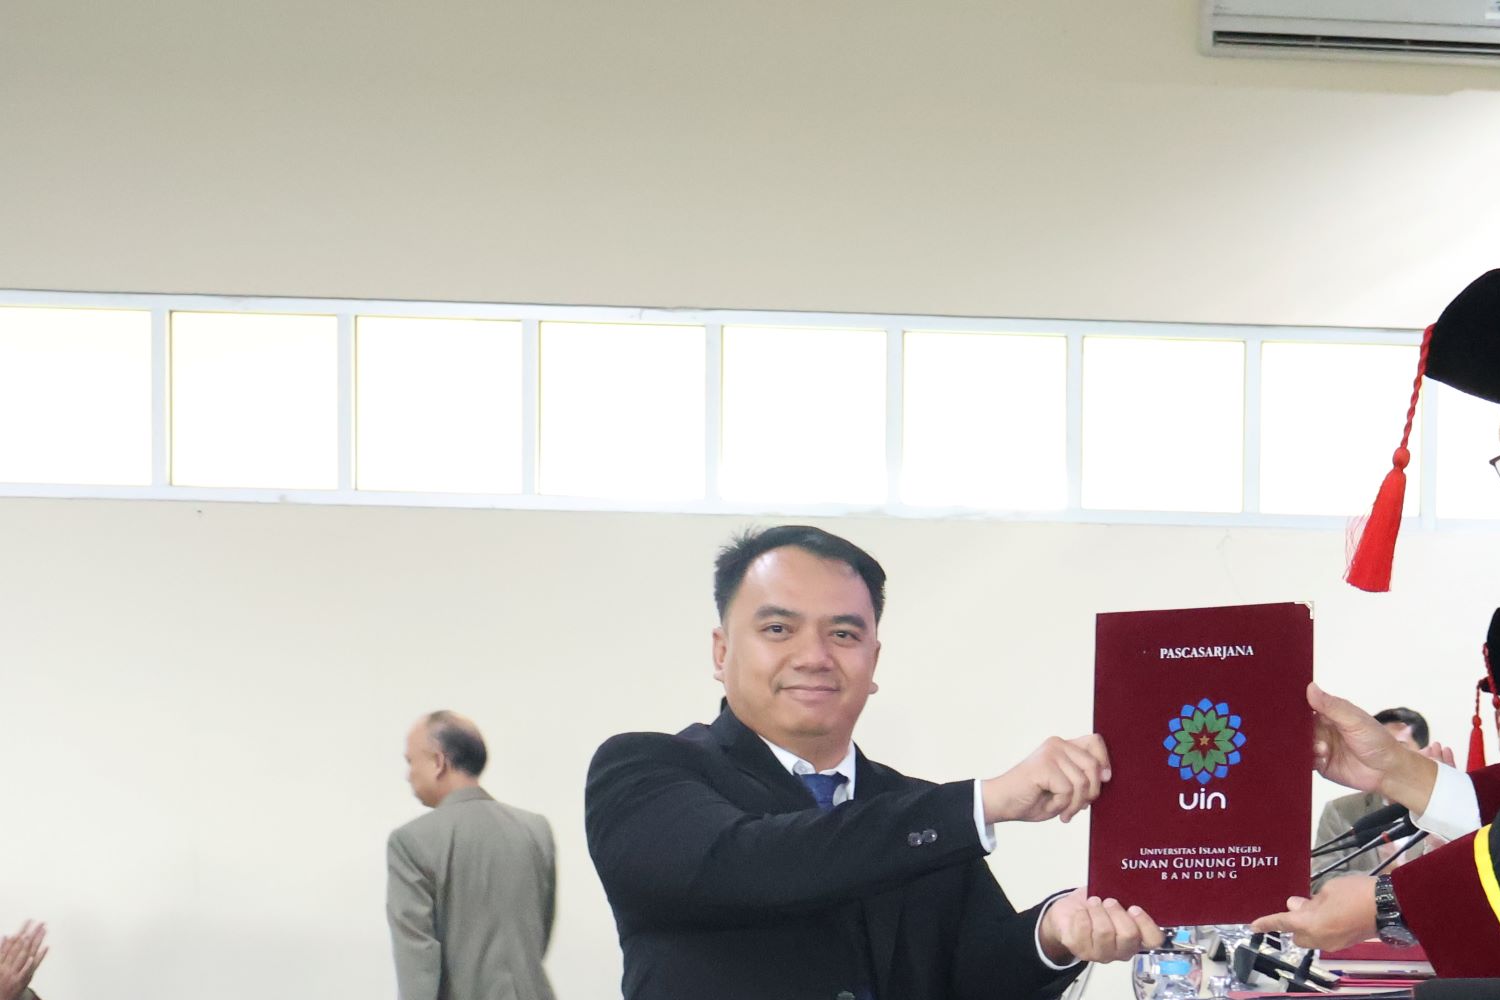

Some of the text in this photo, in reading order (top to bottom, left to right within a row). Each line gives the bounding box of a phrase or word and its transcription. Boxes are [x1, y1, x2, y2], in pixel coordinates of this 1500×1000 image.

[1160, 645, 1254, 660] PASCASARJANA
[1179, 787, 1226, 810] uin
[1140, 846, 1261, 856] UNIVERSITAS ISLAM NEGERI
[1121, 856, 1279, 870] SUNAN GUNUNG DJATI
[1161, 870, 1238, 880] BANDUNG
